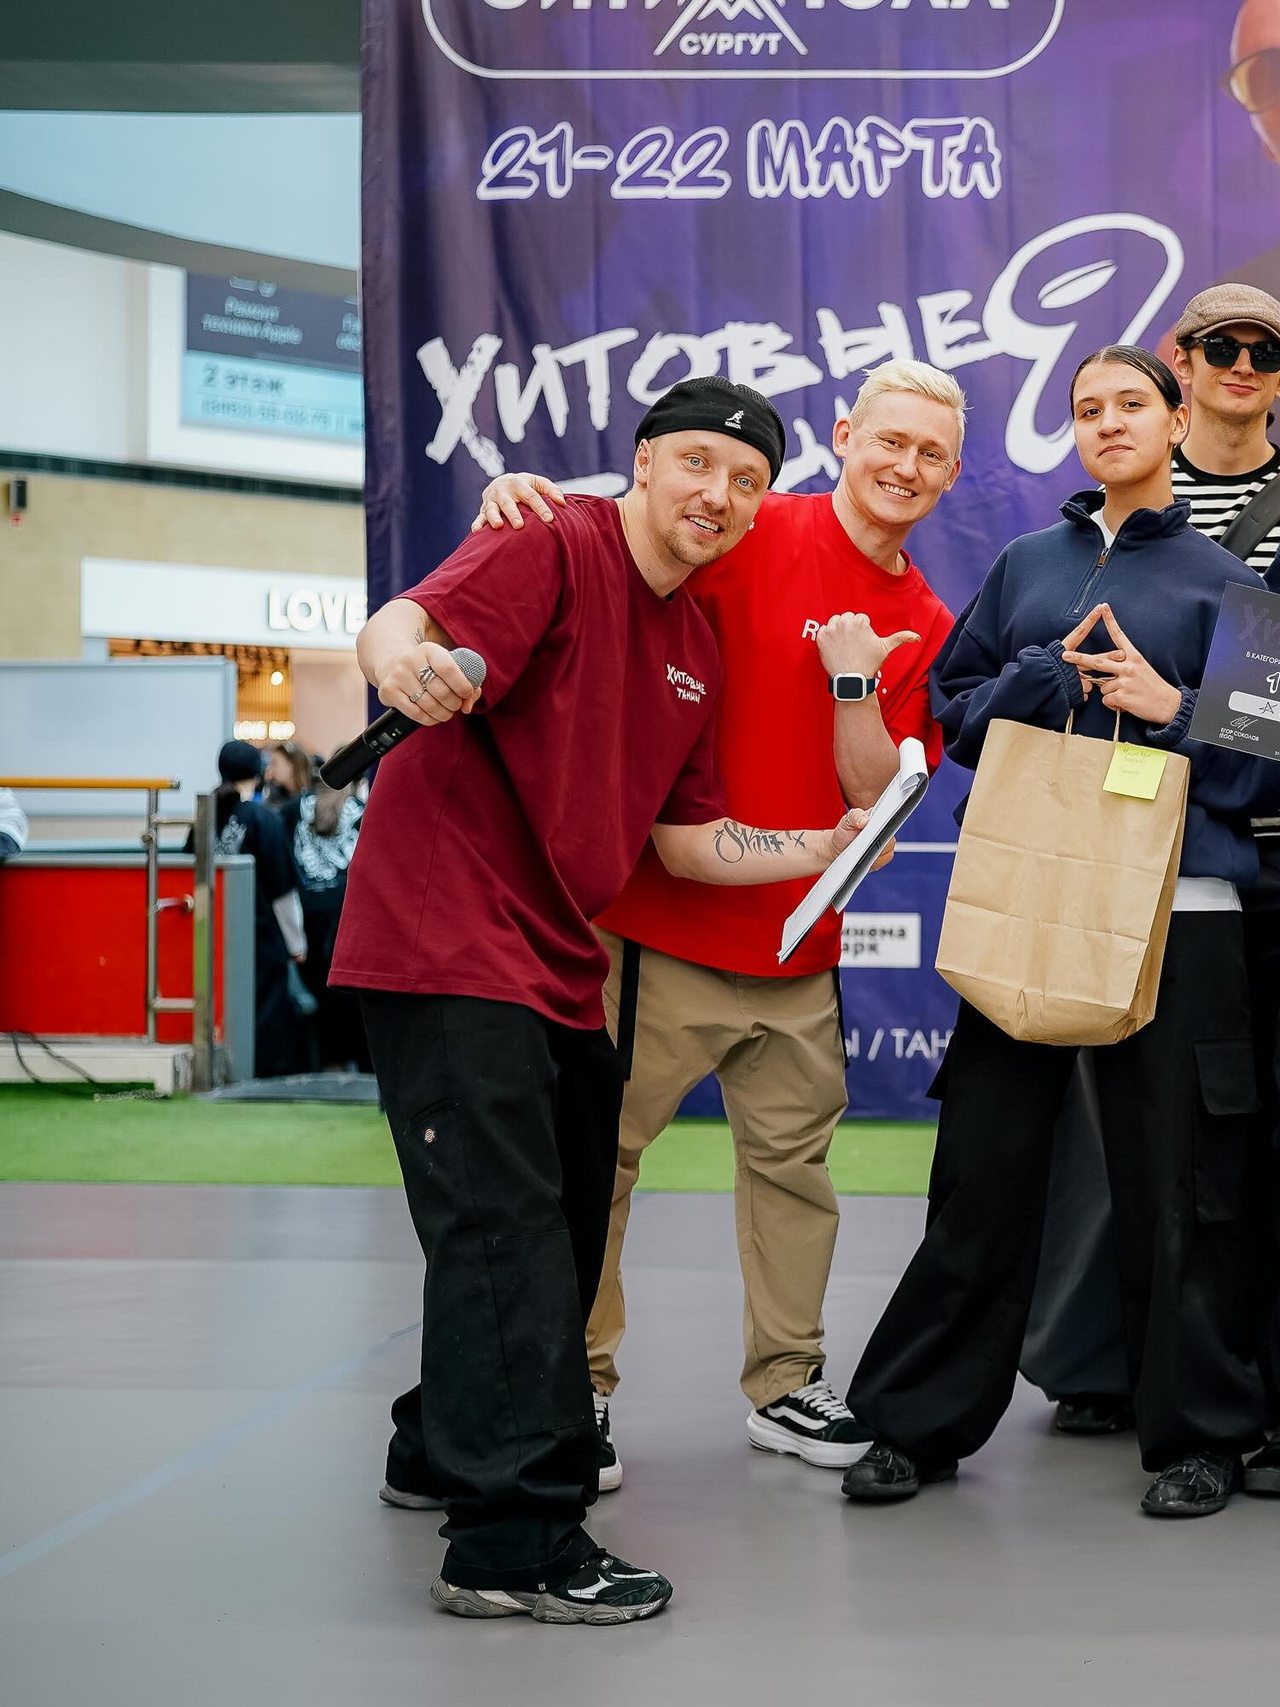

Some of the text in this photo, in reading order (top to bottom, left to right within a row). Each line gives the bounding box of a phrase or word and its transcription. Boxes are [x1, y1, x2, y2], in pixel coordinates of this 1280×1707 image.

[679, 33, 782, 56] СУРГУТ
[476, 115, 1002, 199] 21-22 МАРТА
[416, 288, 995, 478] ХИТОВЫЕ
[667, 664, 706, 695] ХИТОВЫЕ
[1266, 671, 1280, 694] 1
